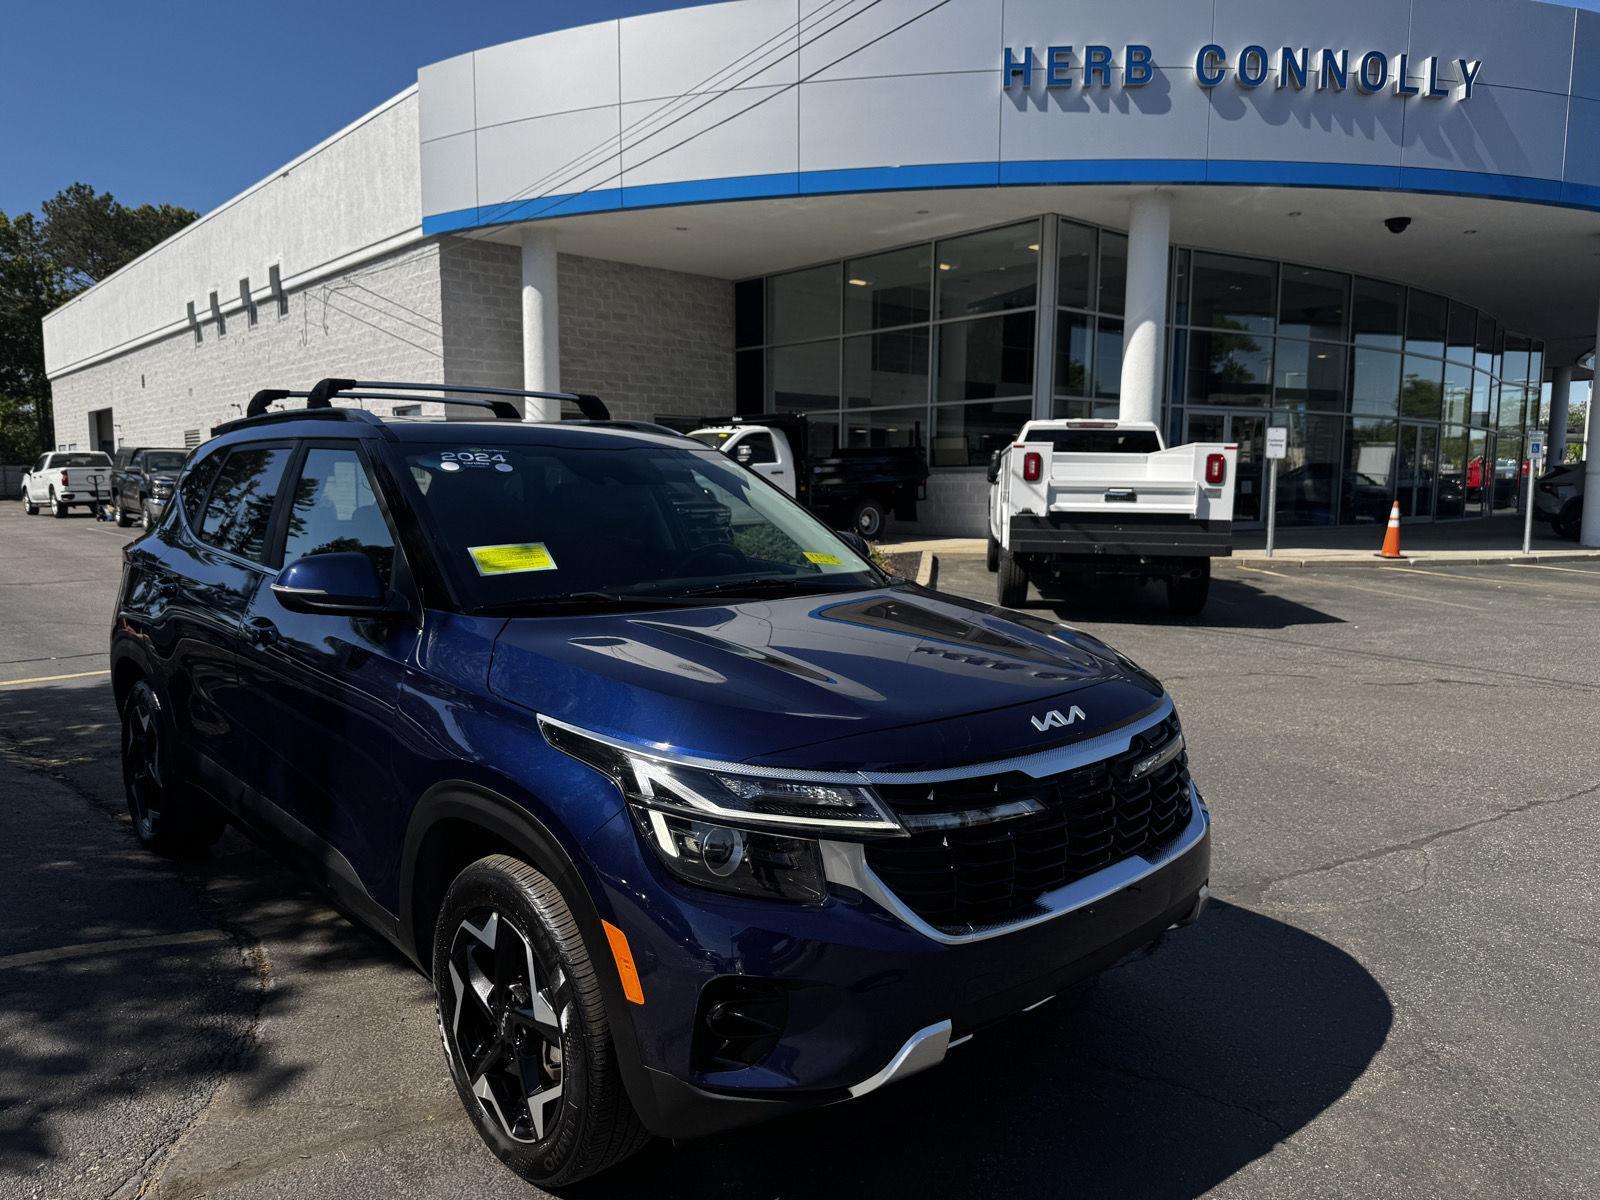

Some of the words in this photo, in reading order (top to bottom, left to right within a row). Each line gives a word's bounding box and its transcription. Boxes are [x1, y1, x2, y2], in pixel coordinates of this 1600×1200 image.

[1003, 44, 1153, 90] HERB
[1194, 43, 1482, 102] CONNOLLY
[440, 452, 506, 462] 2024
[1031, 705, 1086, 732] KIA
